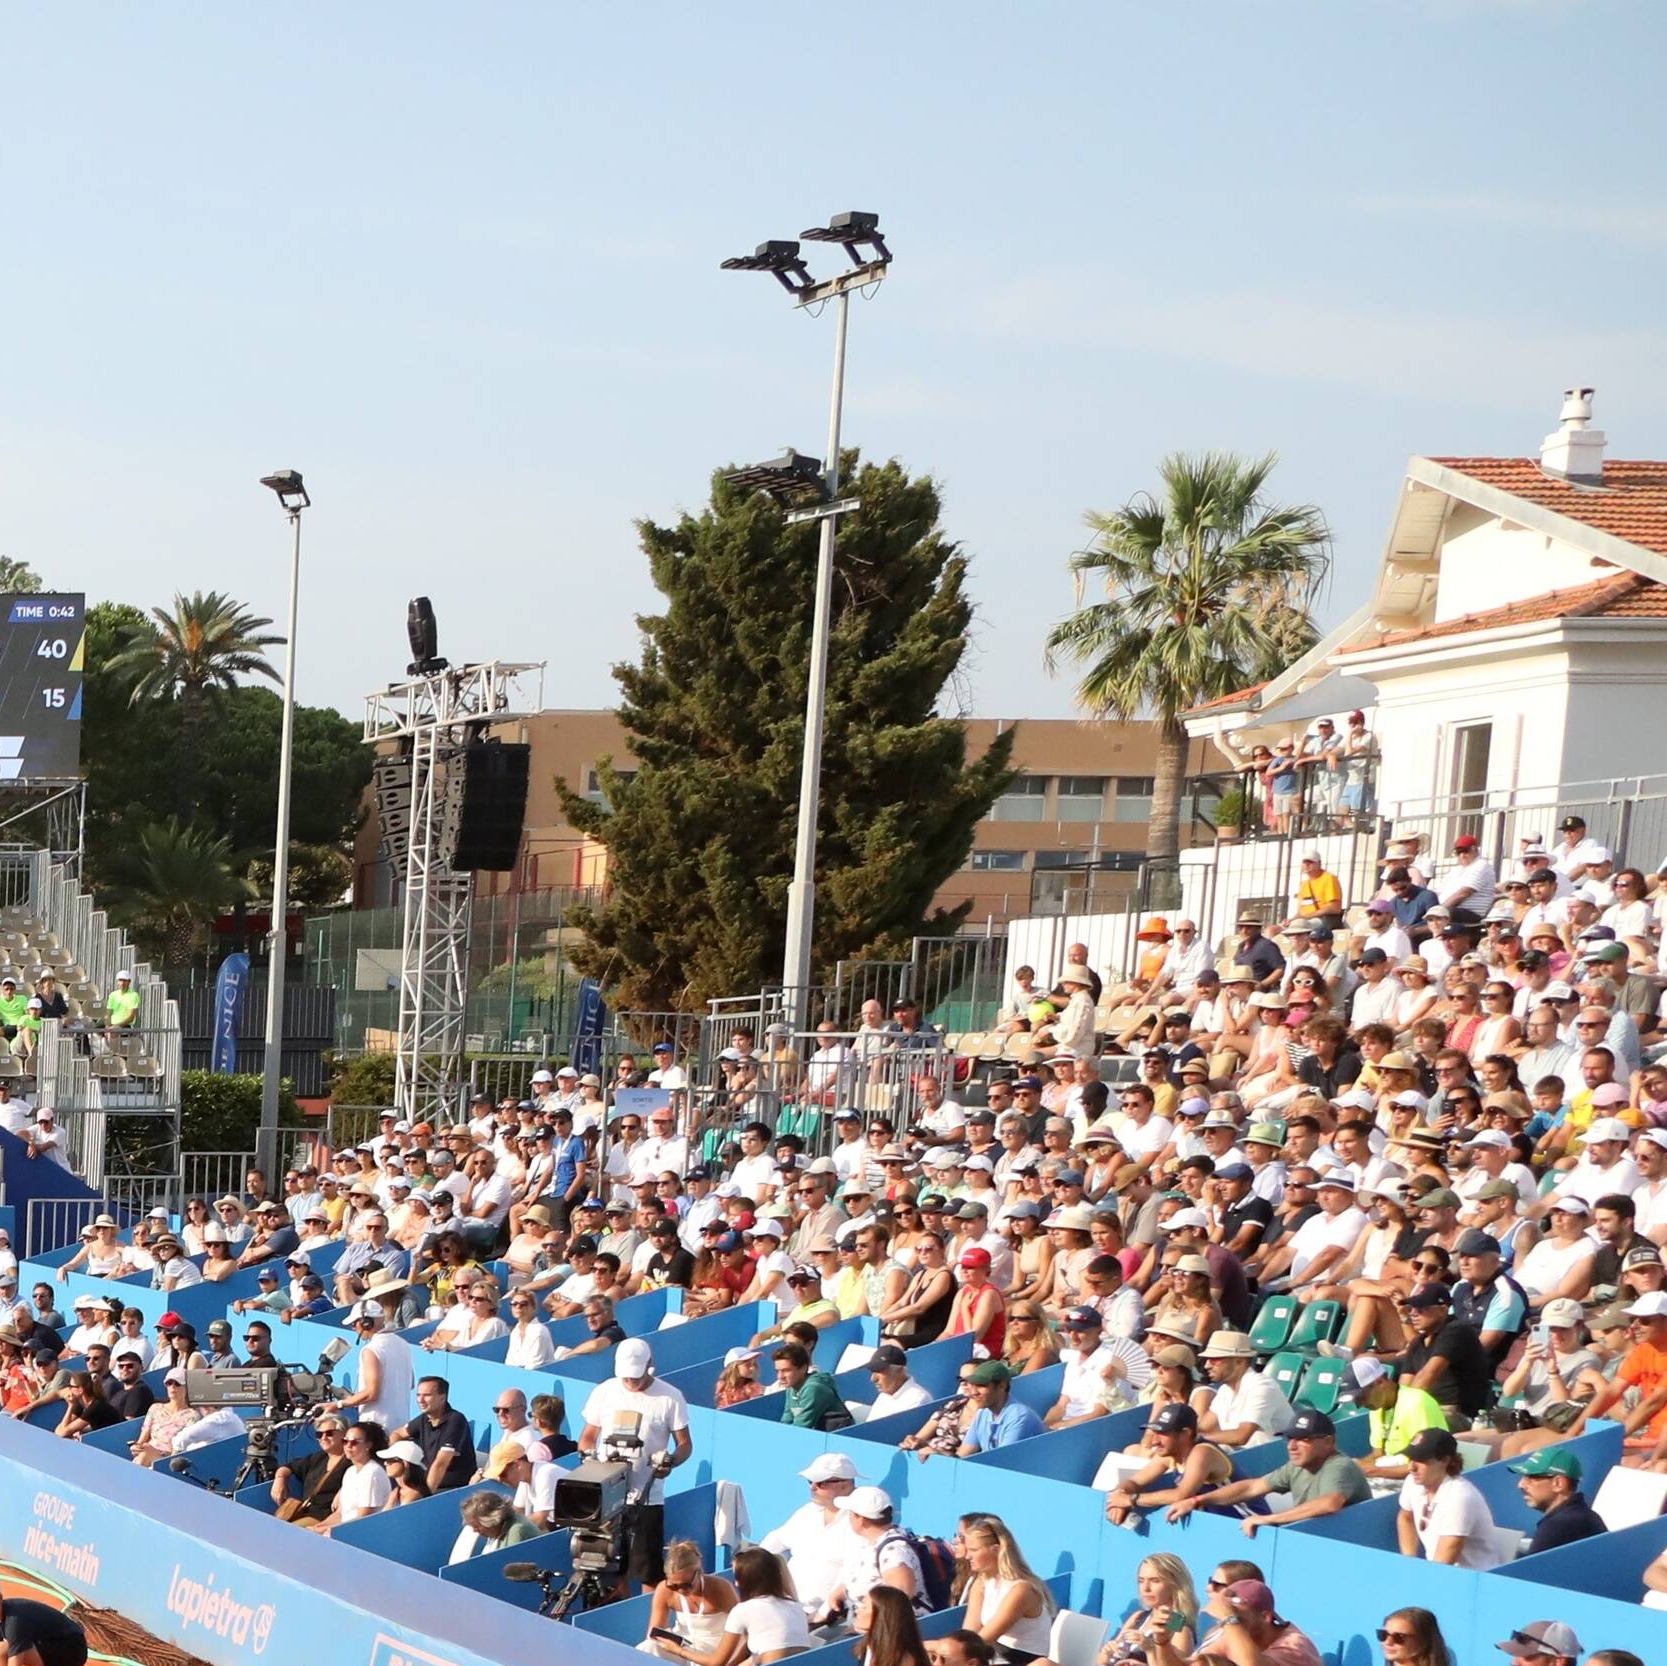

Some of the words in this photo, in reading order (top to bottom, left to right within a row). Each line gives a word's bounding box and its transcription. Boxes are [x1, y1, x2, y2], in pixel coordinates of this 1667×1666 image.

[16, 606, 43, 617] TIME
[49, 606, 75, 617] 0:42
[37, 639, 67, 658] 40
[43, 689, 65, 707] 15
[33, 1491, 76, 1531] GROUPE
[24, 1521, 100, 1586] nice-matin
